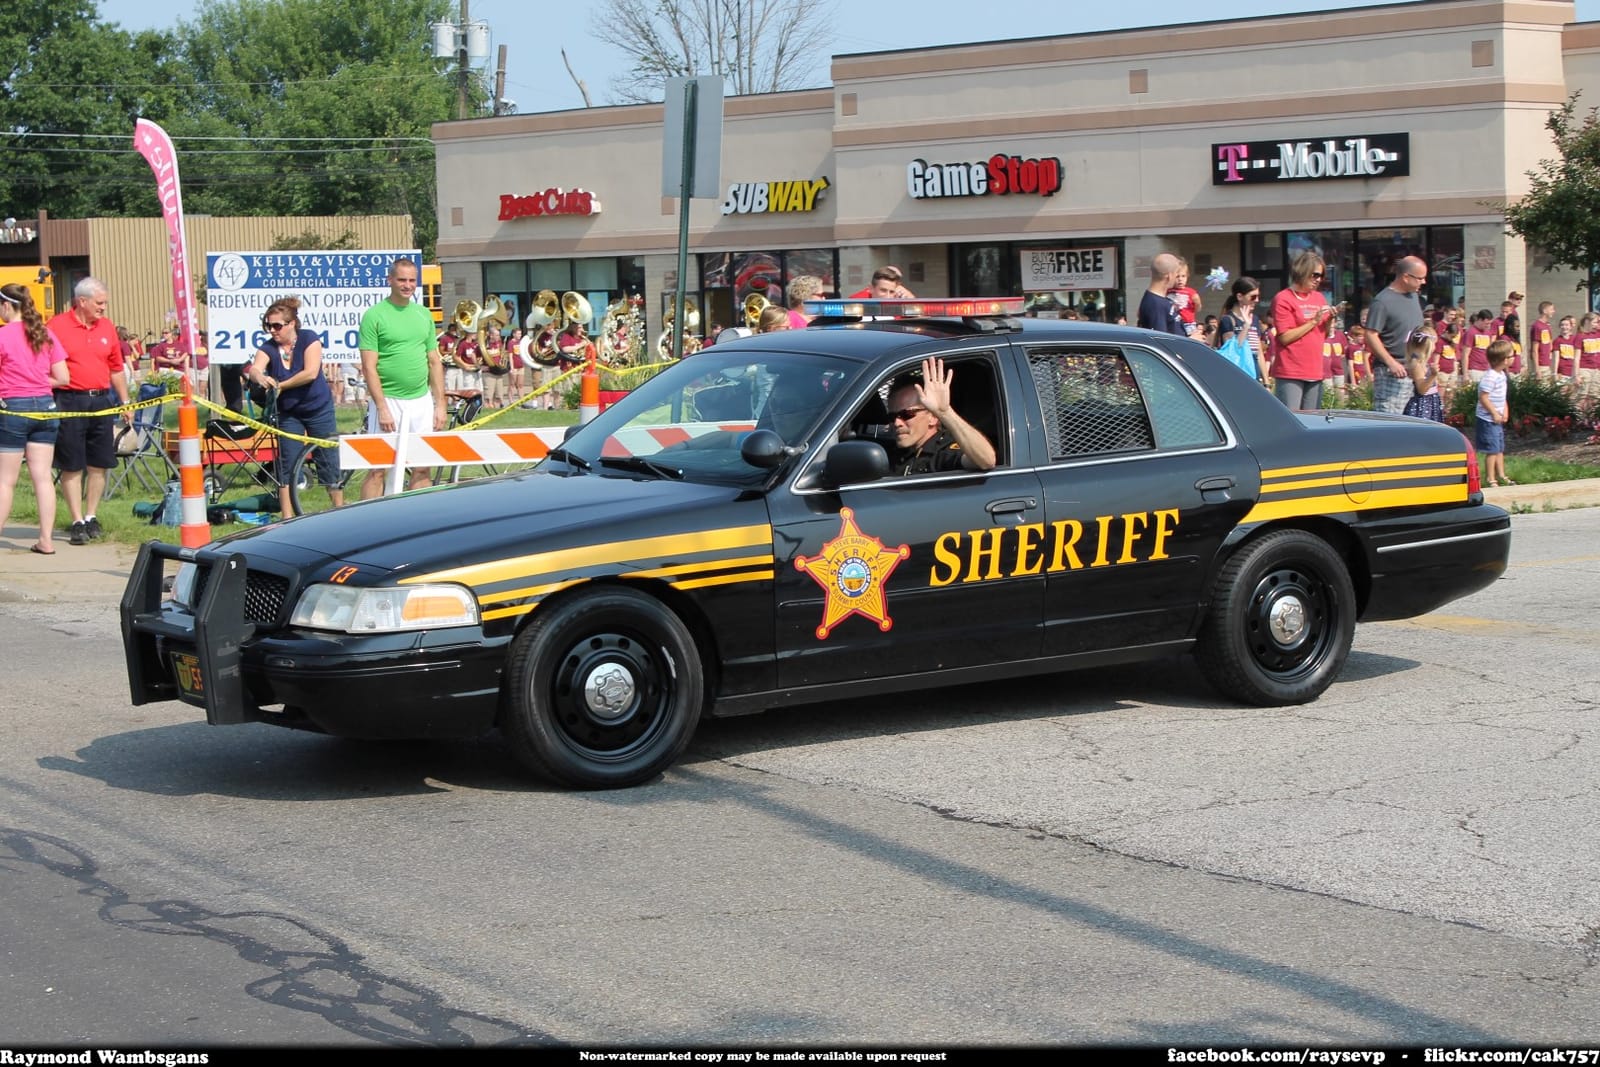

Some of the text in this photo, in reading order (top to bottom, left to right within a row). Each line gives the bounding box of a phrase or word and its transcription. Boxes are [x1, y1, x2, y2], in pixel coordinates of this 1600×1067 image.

[907, 154, 1061, 199] GameStop
[720, 177, 829, 215] SUBWAY
[1056, 250, 1103, 273] FREE
[262, 277, 390, 288] COMMERCIAL REAL EST
[929, 508, 1180, 586] SHERIFF
[329, 565, 358, 584] 13
[830, 548, 878, 576] SHERIFF
